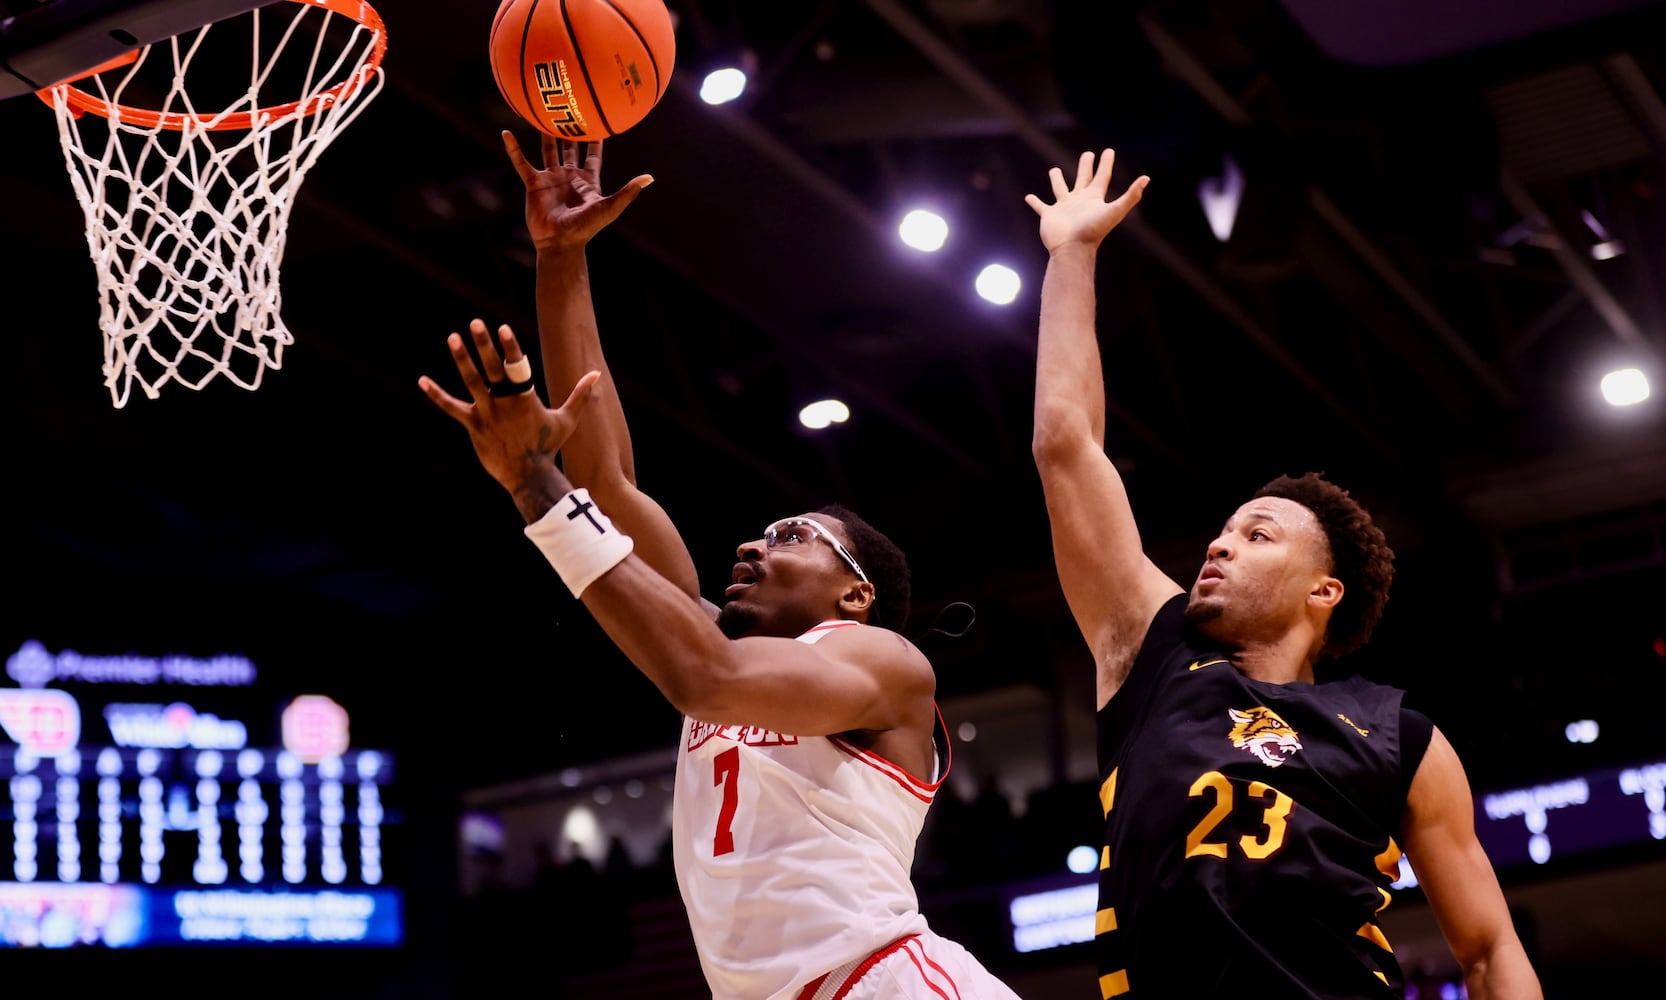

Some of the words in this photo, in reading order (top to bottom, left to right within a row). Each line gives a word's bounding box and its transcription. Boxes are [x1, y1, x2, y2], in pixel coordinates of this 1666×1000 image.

[534, 61, 587, 137] ELITE
[713, 745, 740, 857] 7
[1185, 770, 1294, 860] 23
